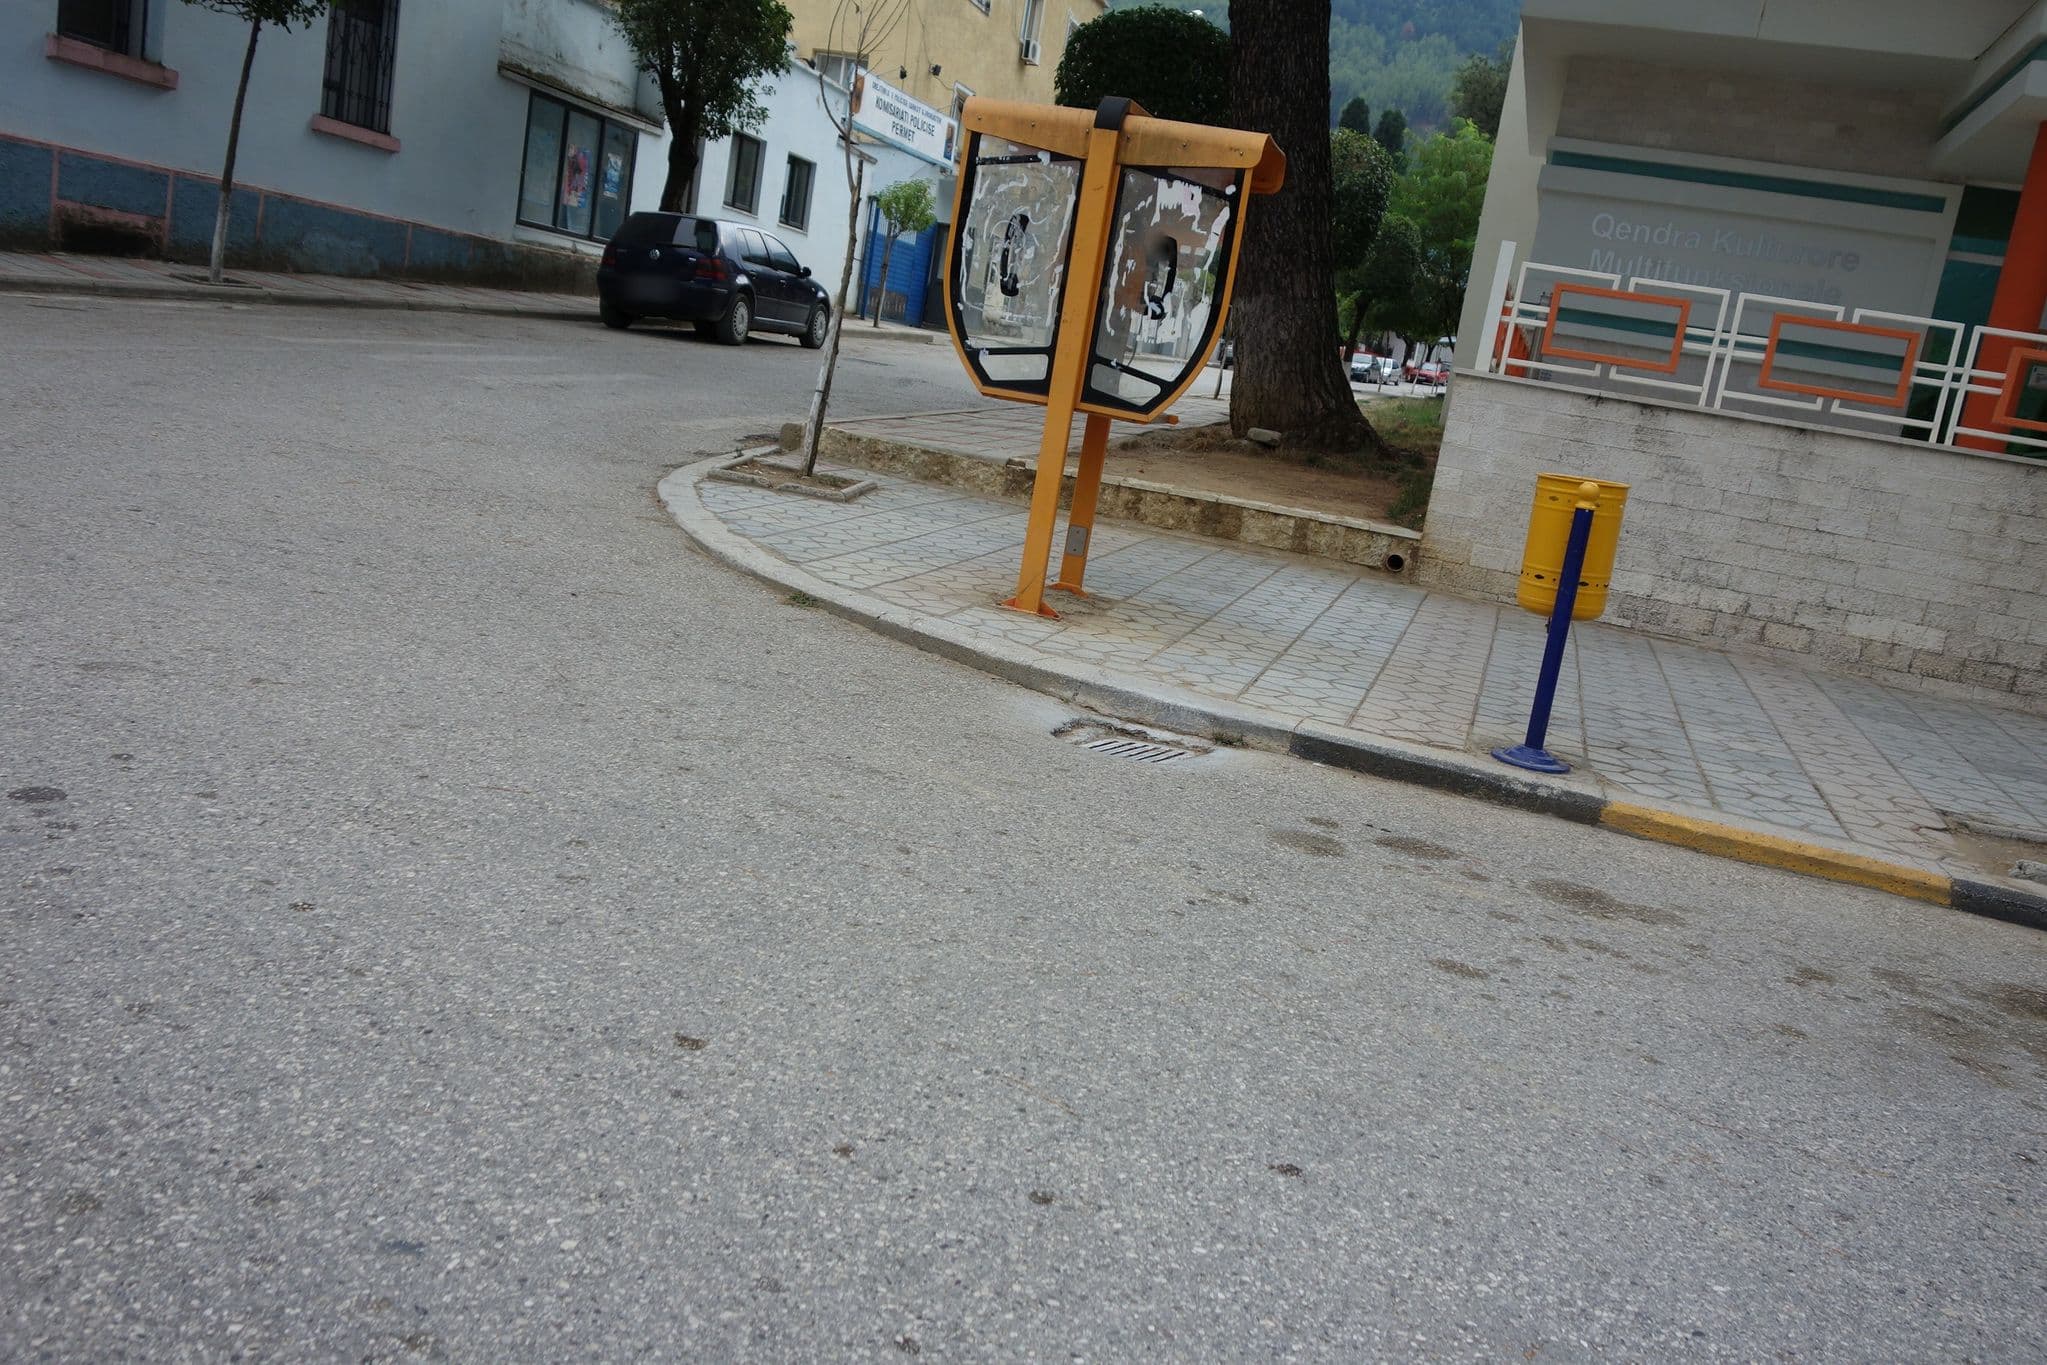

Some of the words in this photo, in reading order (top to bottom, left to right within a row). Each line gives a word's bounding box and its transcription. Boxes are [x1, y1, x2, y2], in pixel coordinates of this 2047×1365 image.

[875, 96, 909, 124] KOMISARIATI
[911, 113, 935, 137] POLICISE
[891, 120, 915, 142] PERMET
[1592, 213, 1703, 249] Qendra
